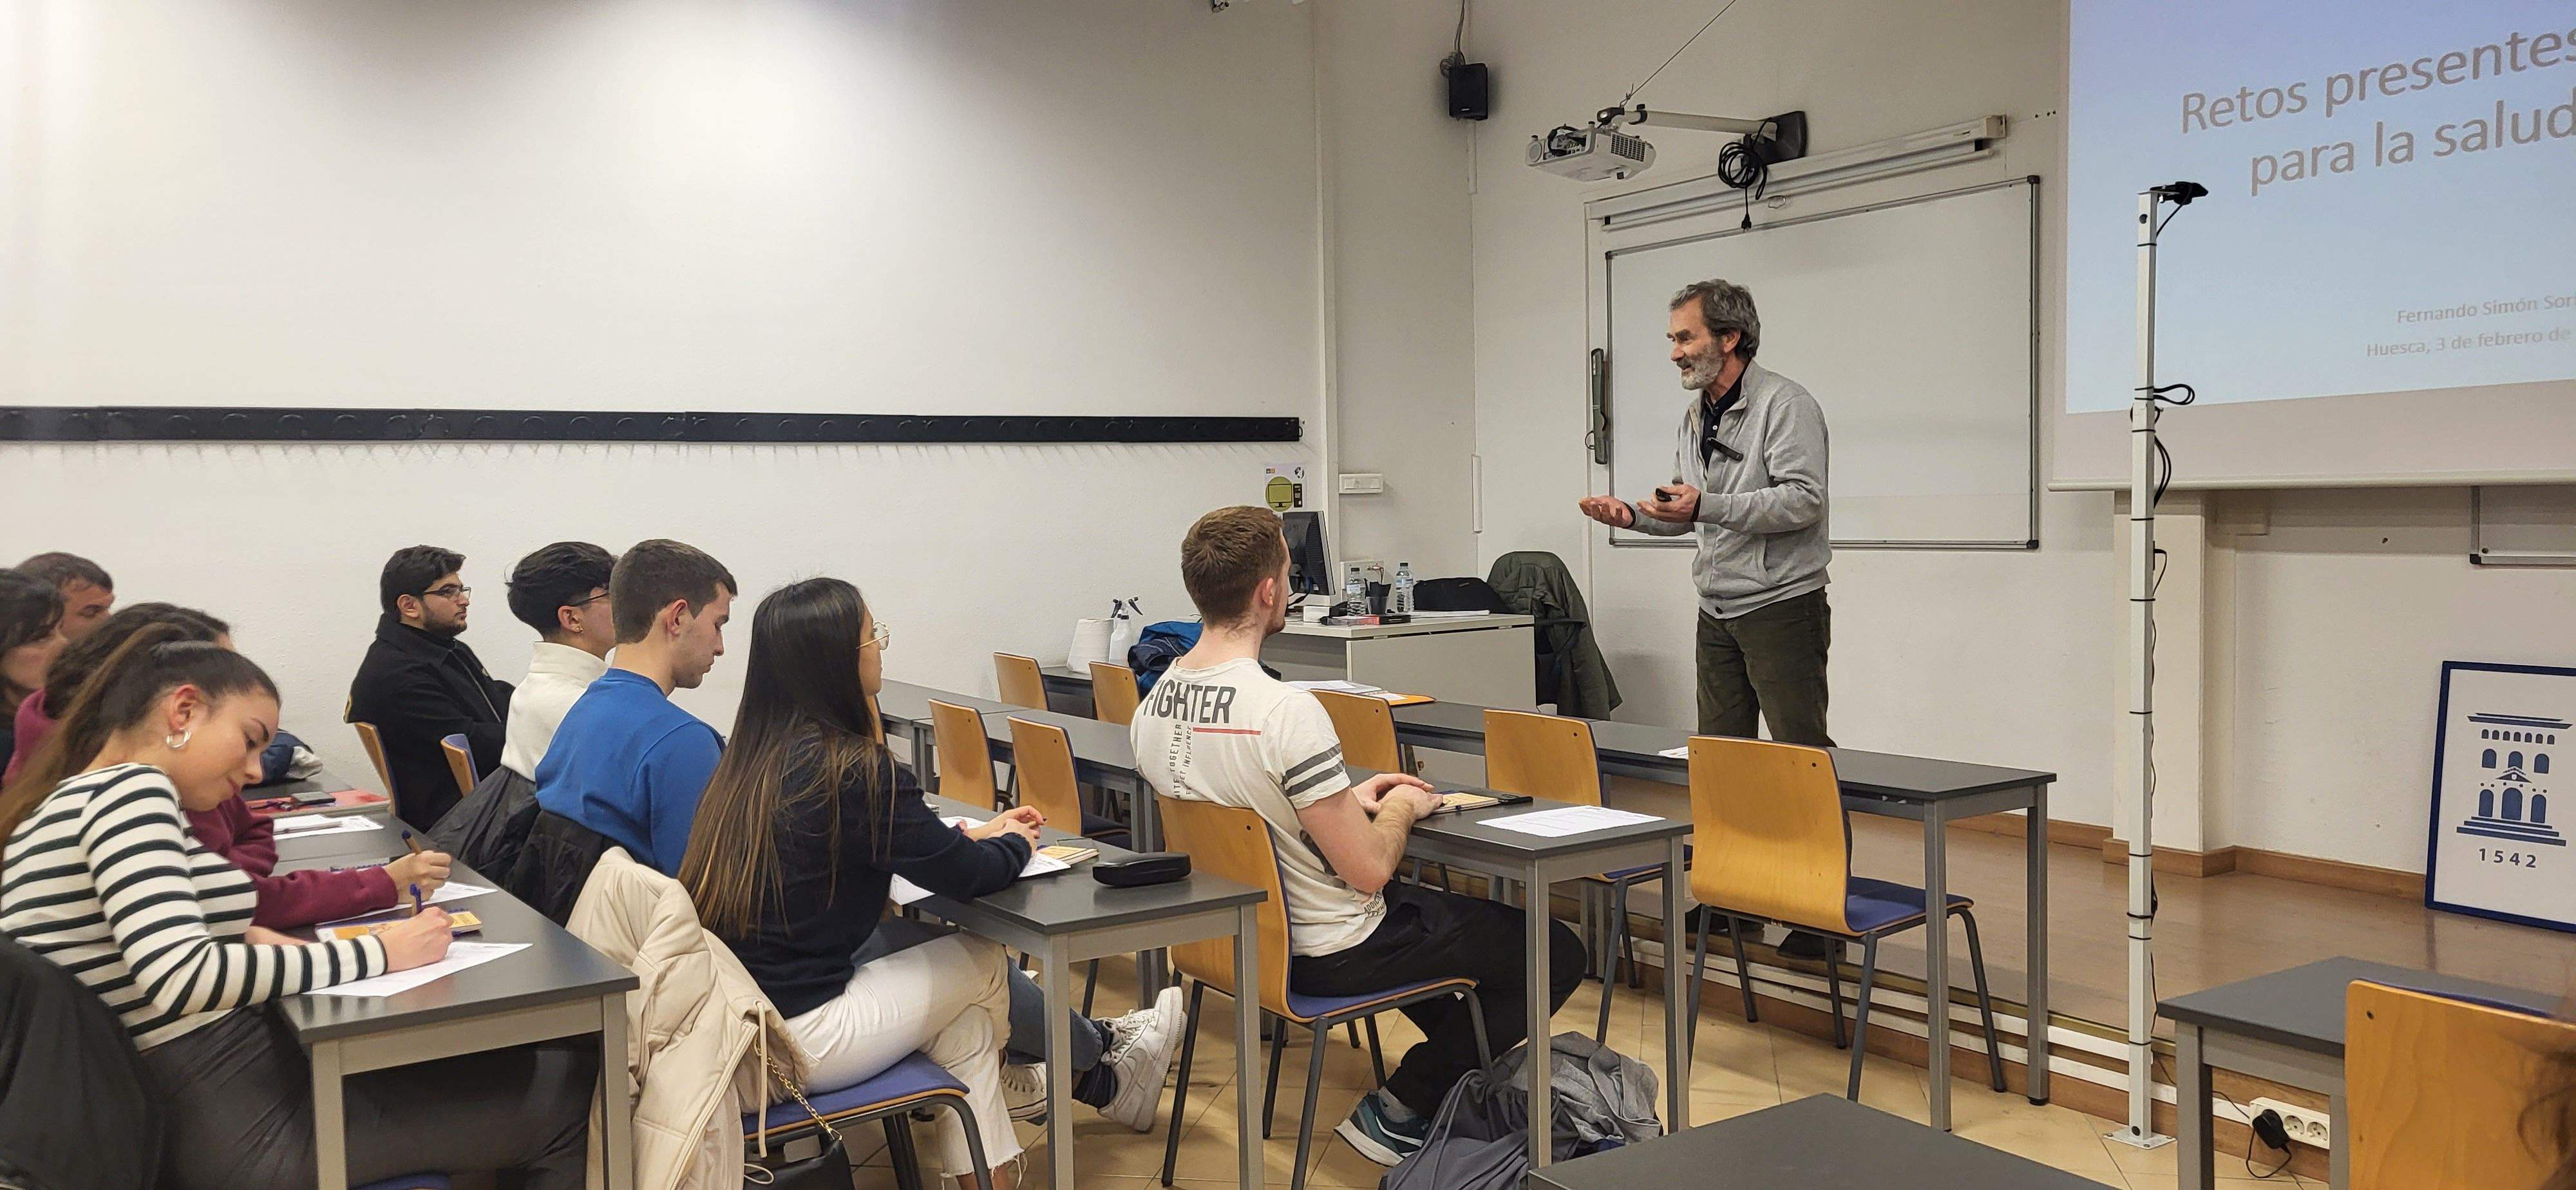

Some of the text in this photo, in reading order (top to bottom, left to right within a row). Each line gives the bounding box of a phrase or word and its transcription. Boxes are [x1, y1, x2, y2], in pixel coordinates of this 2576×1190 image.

[2182, 82, 2307, 133] Retos
[2251, 86, 2576, 196] para la salud
[2397, 304, 2477, 323] Fernando
[2483, 298, 2538, 316] Simón
[2367, 326, 2571, 357] Huesca, 3 de febrero de
[1169, 724, 1182, 772] TOGETHER
[2479, 848, 2536, 868] 1542
